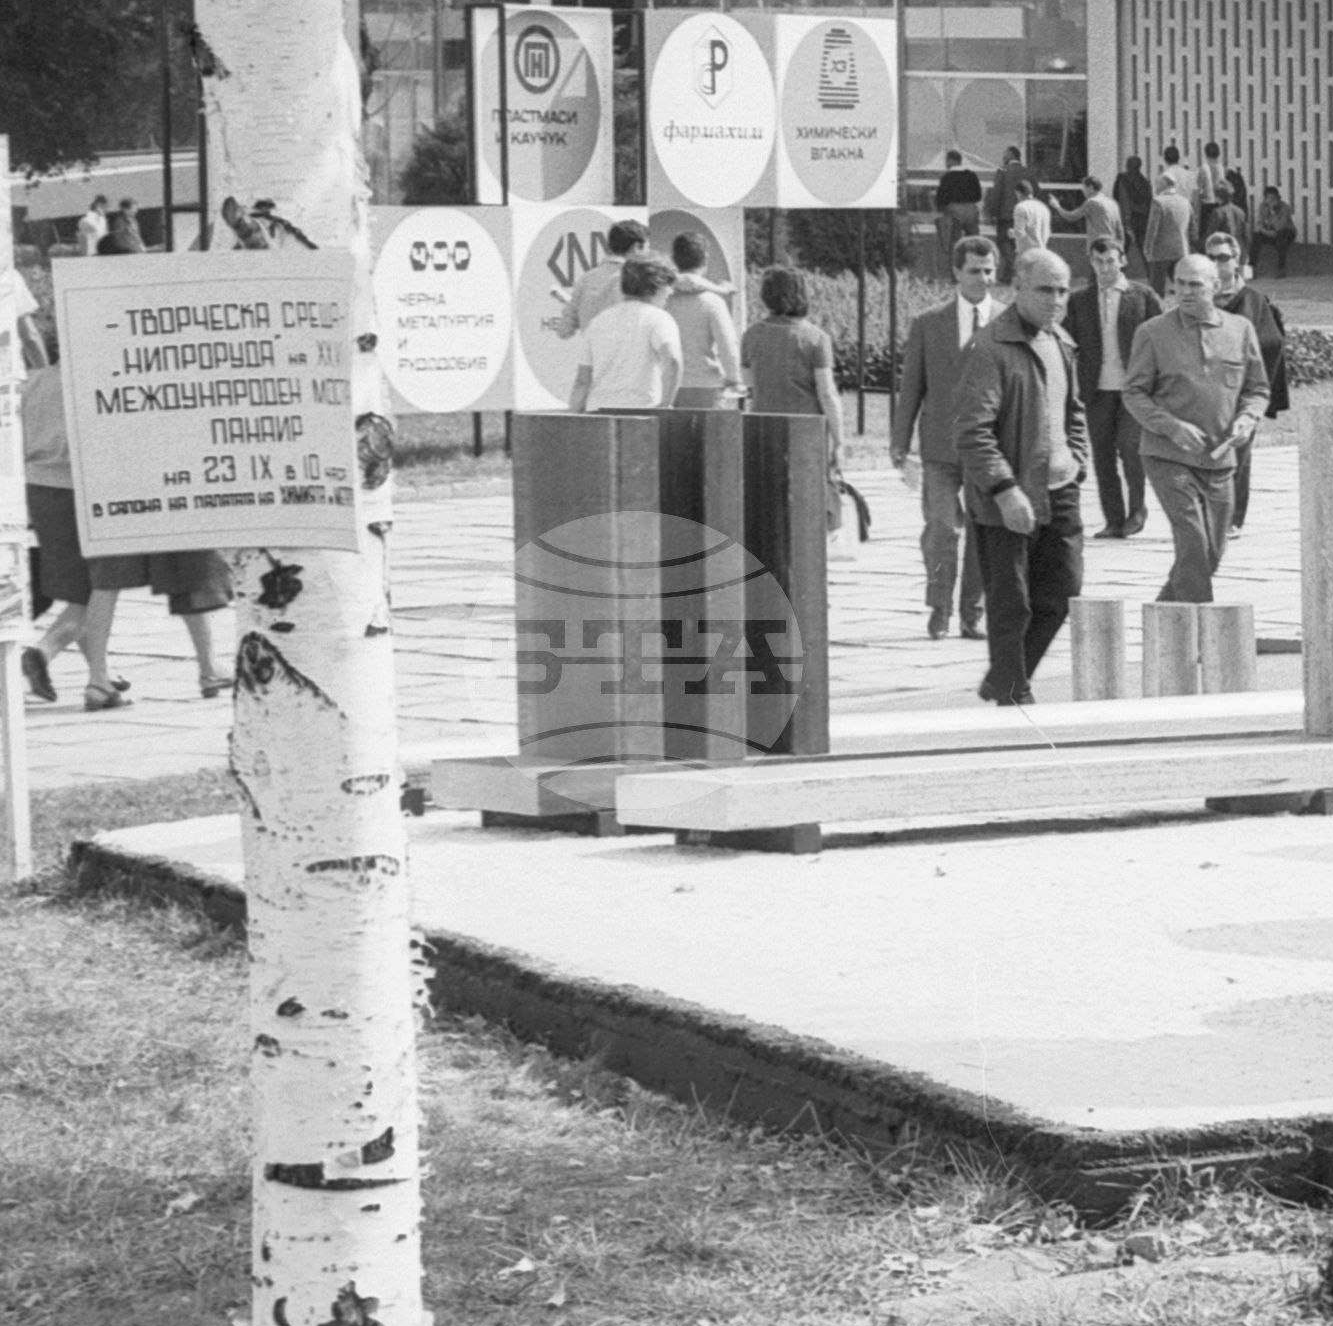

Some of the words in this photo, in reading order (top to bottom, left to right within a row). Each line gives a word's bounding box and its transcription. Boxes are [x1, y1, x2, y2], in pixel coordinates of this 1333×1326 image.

[511, 131, 568, 145] КАУЧУК
[663, 120, 763, 142] фармахим
[796, 126, 878, 139] ХИМИЧЕСКИ
[811, 147, 865, 160] ВЛАКНА
[398, 292, 446, 306] ЧЕРНА
[125, 302, 270, 335] ТВОРЧЕСКА
[398, 314, 494, 328] МЕТАЛУРГИЯ
[398, 356, 488, 371] РУДОДОБИВ
[95, 378, 302, 414] МЕЖДУНАРОДЕН
[210, 415, 304, 445] ПАНАИР
[203, 455, 237, 484] 23
[303, 454, 320, 480] 10
